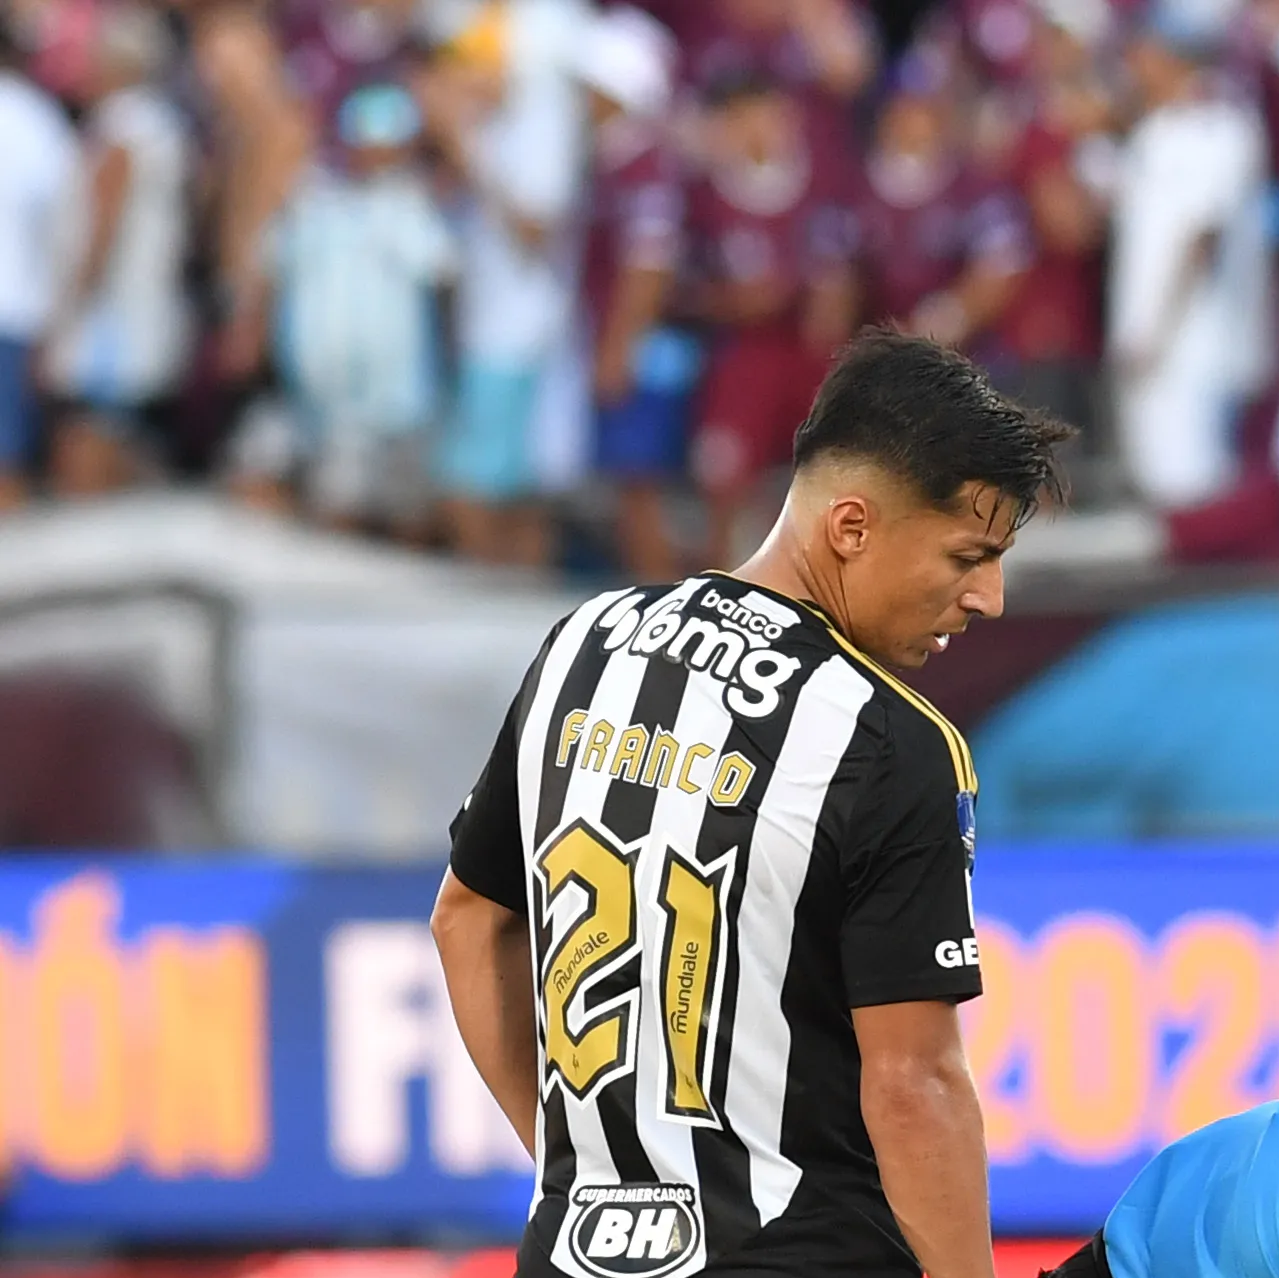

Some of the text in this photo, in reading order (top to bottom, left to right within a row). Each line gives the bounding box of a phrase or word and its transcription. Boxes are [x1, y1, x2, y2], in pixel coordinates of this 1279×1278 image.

[701, 589, 783, 639] banco
[632, 599, 801, 718] bmg
[555, 709, 757, 807] FRANCO
[533, 817, 737, 1131] 21
[552, 929, 610, 995] mundiale
[670, 941, 699, 1034] mundiale
[576, 1187, 693, 1203] SUPERMERCADOS
[586, 1208, 678, 1259] BH
